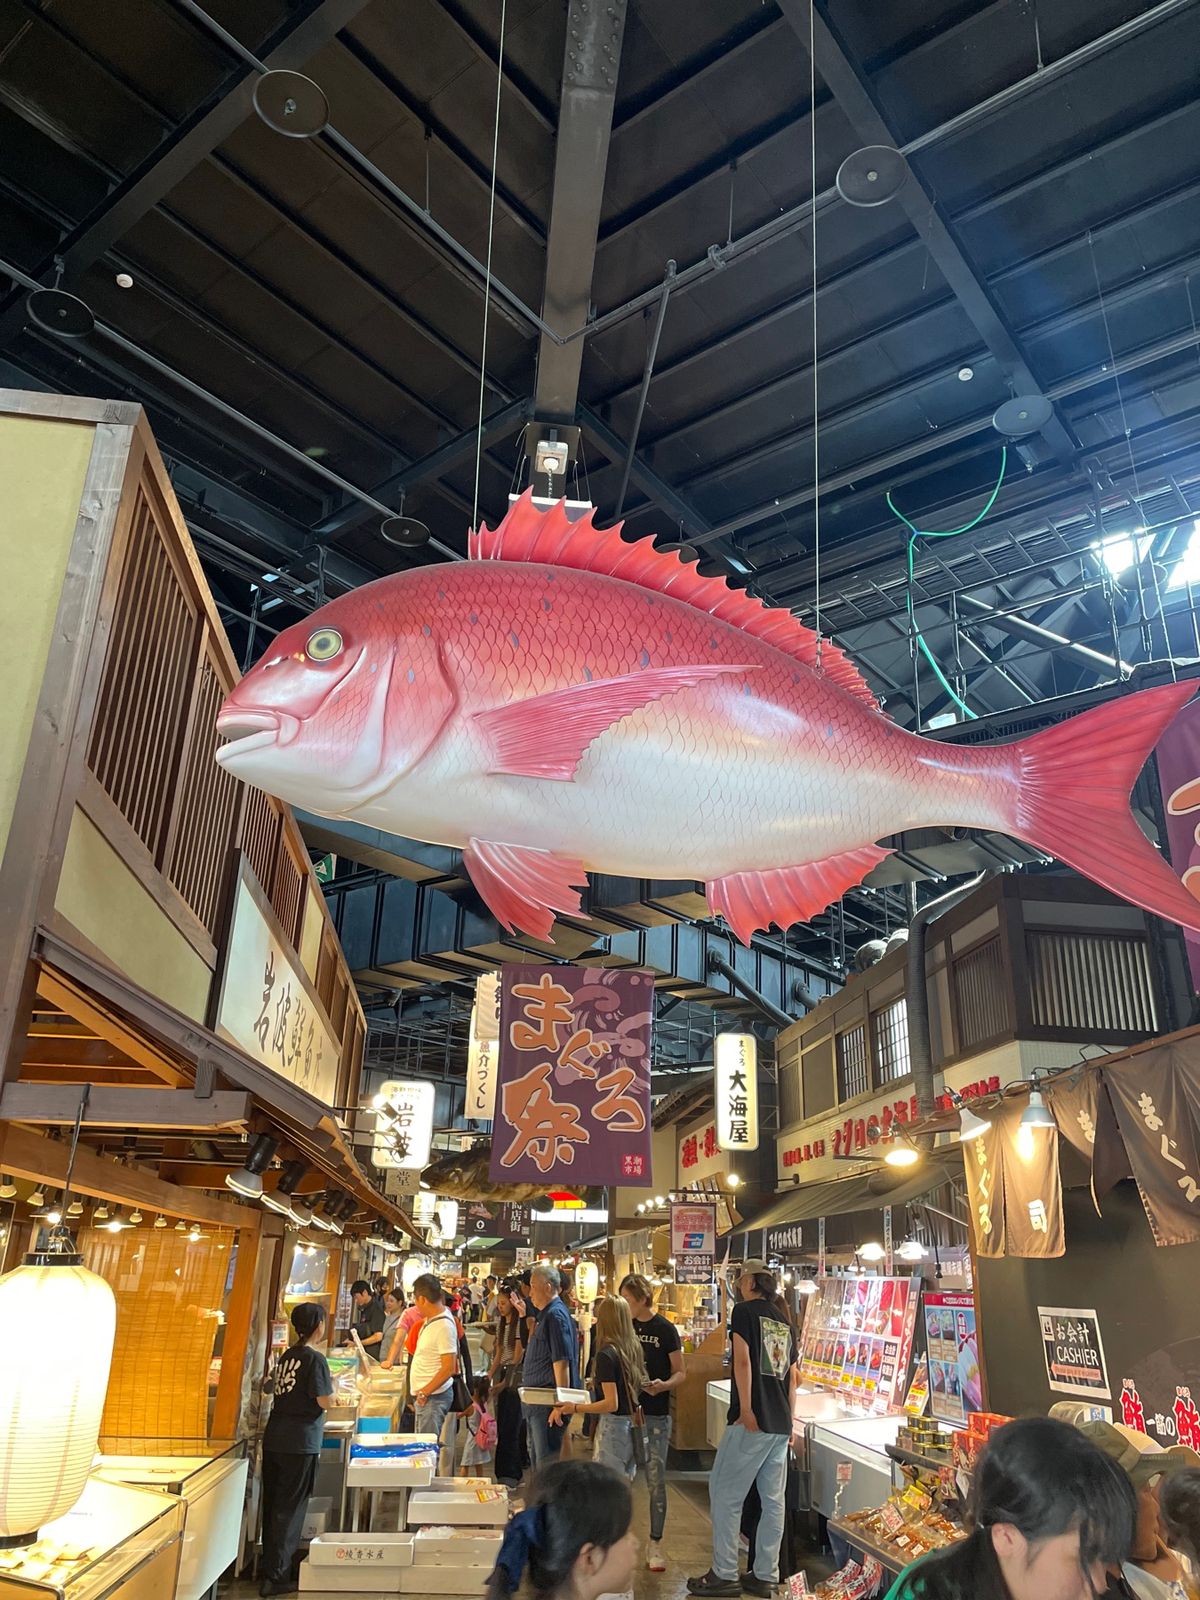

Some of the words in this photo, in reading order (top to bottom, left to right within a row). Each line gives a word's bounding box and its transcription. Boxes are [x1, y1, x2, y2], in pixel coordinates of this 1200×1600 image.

[738, 1039, 746, 1067] まぐろ
[501, 1062, 590, 1173] 祭
[728, 1069, 750, 1143] 大海屋
[975, 1137, 992, 1235] まぐろ
[684, 1255, 711, 1266] お会計
[1056, 1321, 1089, 1345] お会計
[1056, 1346, 1099, 1367] CASHIER
